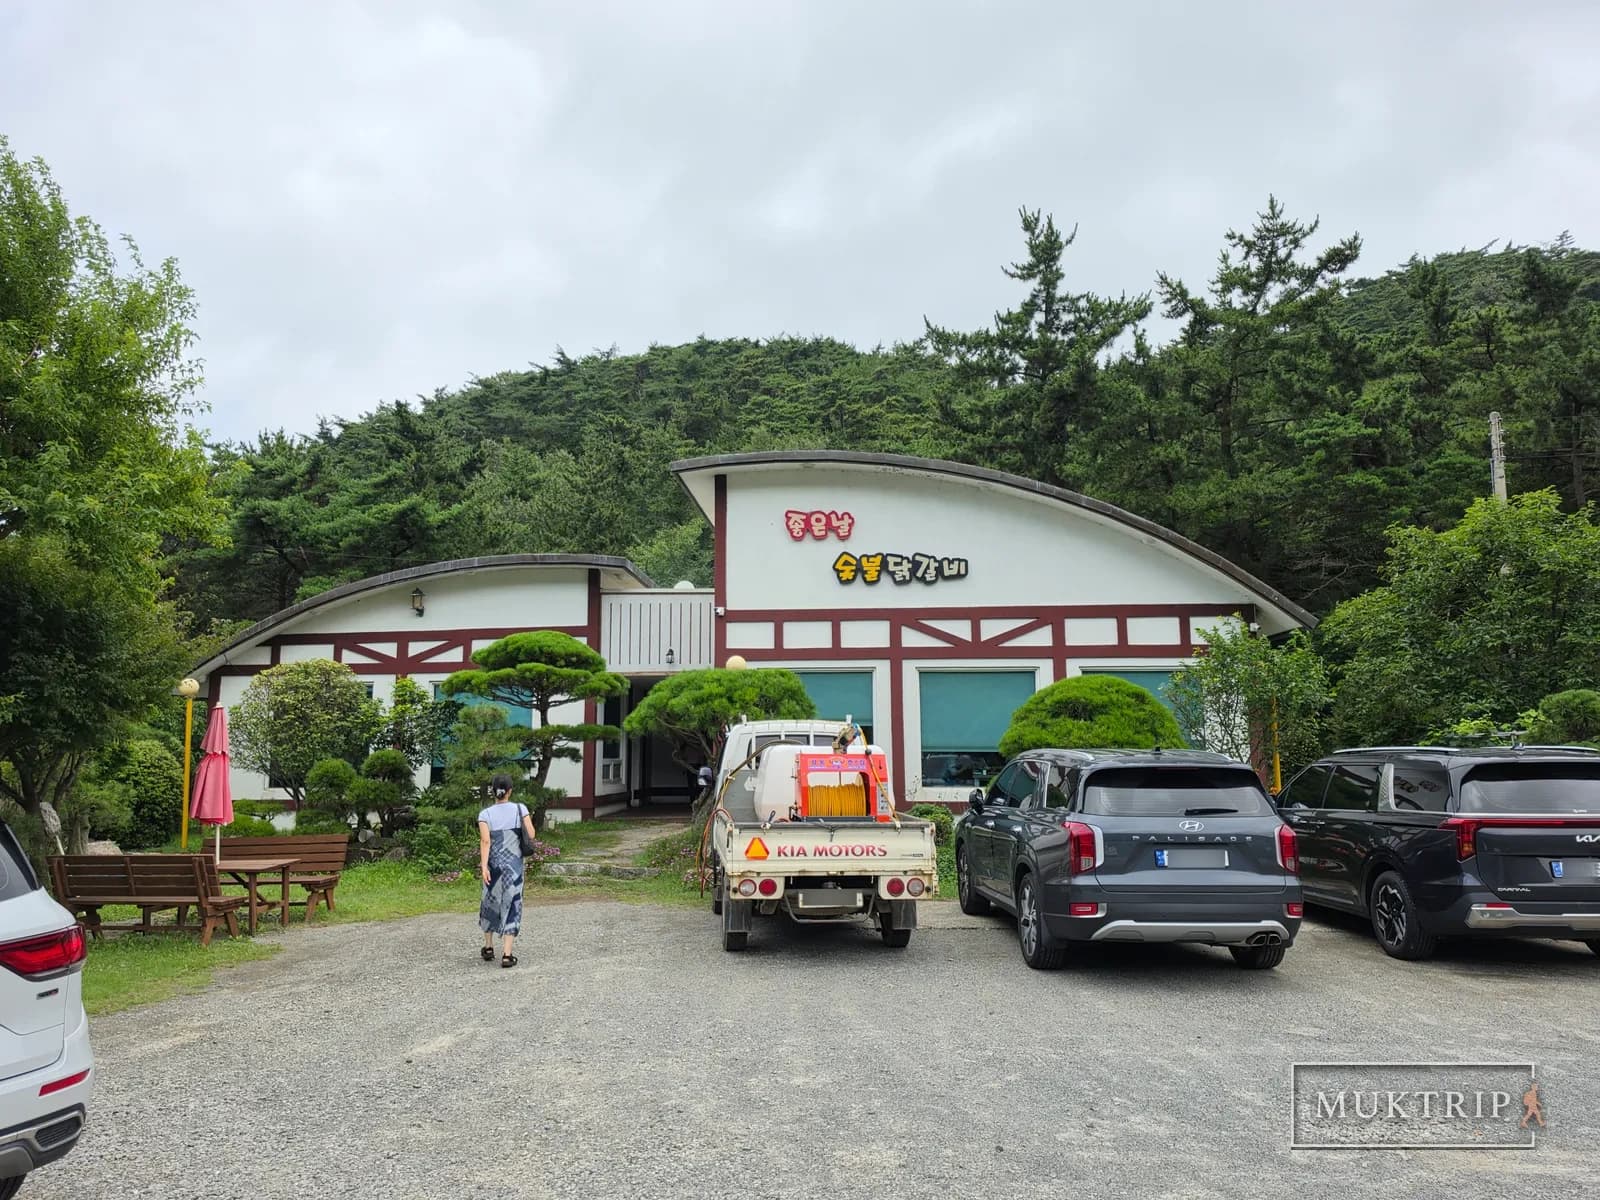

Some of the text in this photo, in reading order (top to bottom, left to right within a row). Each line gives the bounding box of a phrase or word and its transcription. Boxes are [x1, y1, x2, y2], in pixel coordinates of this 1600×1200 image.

[1131, 834, 1252, 842] PALISADE
[777, 844, 888, 858] KIA MOTORS
